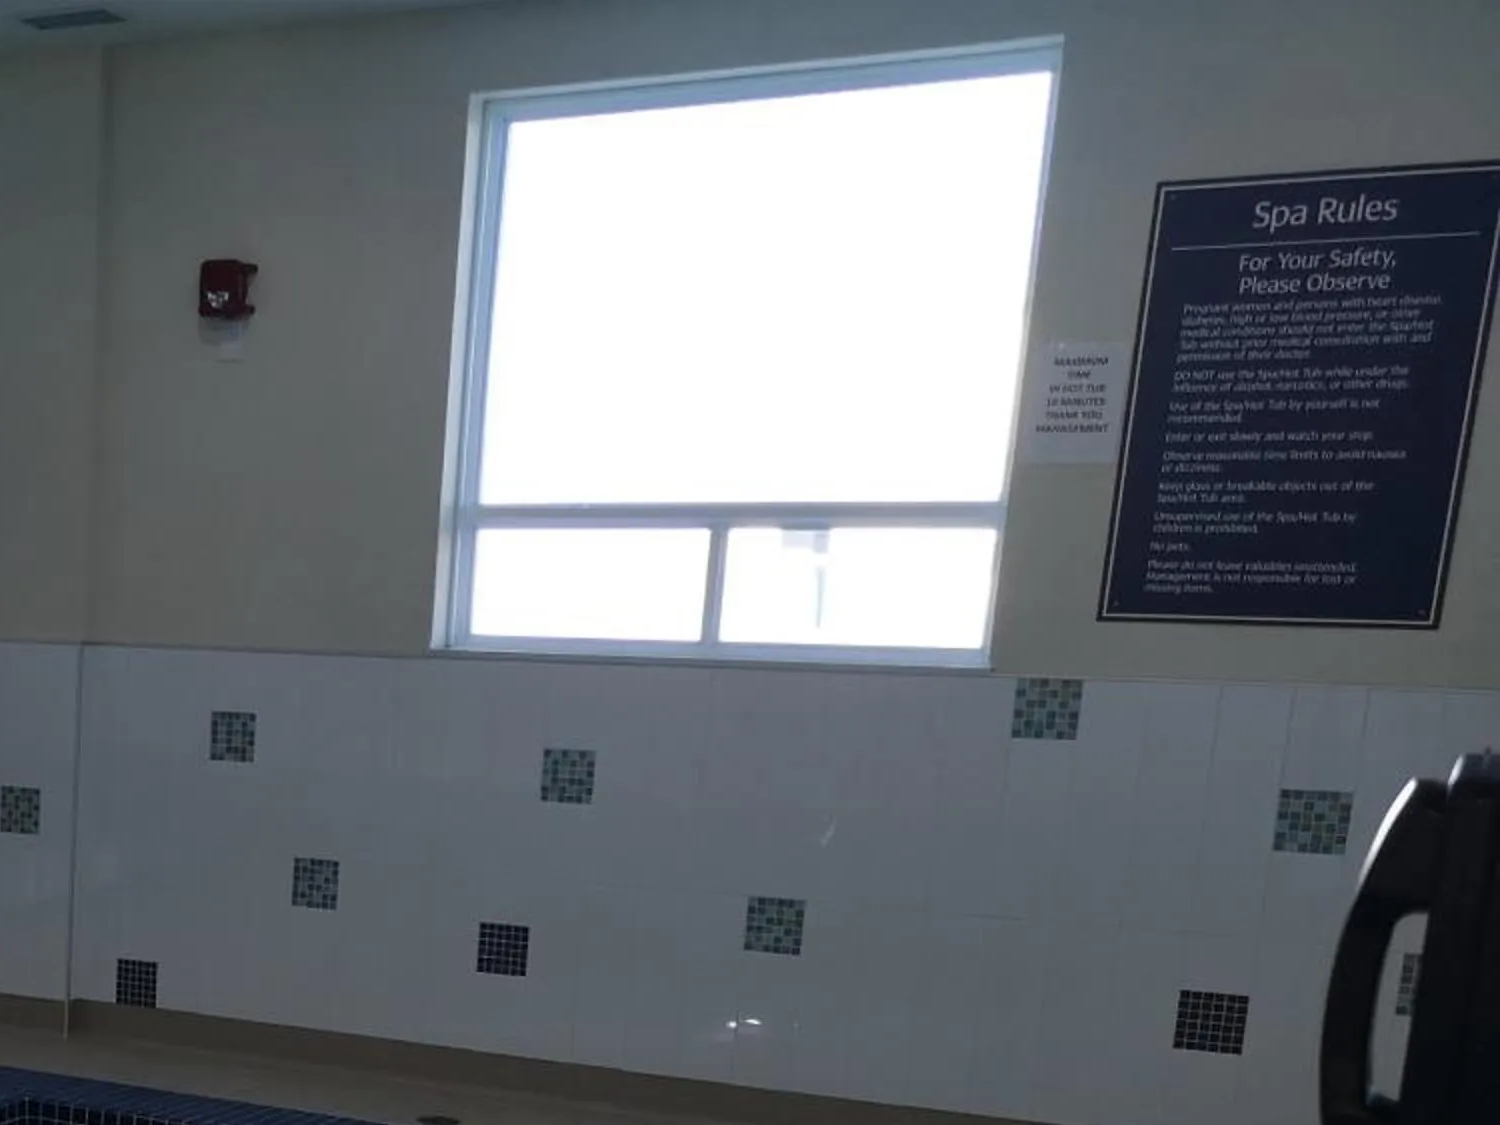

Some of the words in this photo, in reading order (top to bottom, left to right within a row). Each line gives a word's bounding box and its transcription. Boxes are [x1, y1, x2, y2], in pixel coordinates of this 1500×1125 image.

[1252, 200, 1308, 235] Spa
[1317, 193, 1400, 226] Rules
[1239, 253, 1272, 272] For
[1278, 251, 1325, 271] Your
[1329, 247, 1396, 271] Safety,
[1238, 275, 1301, 296] Please
[1307, 272, 1391, 293] Observe
